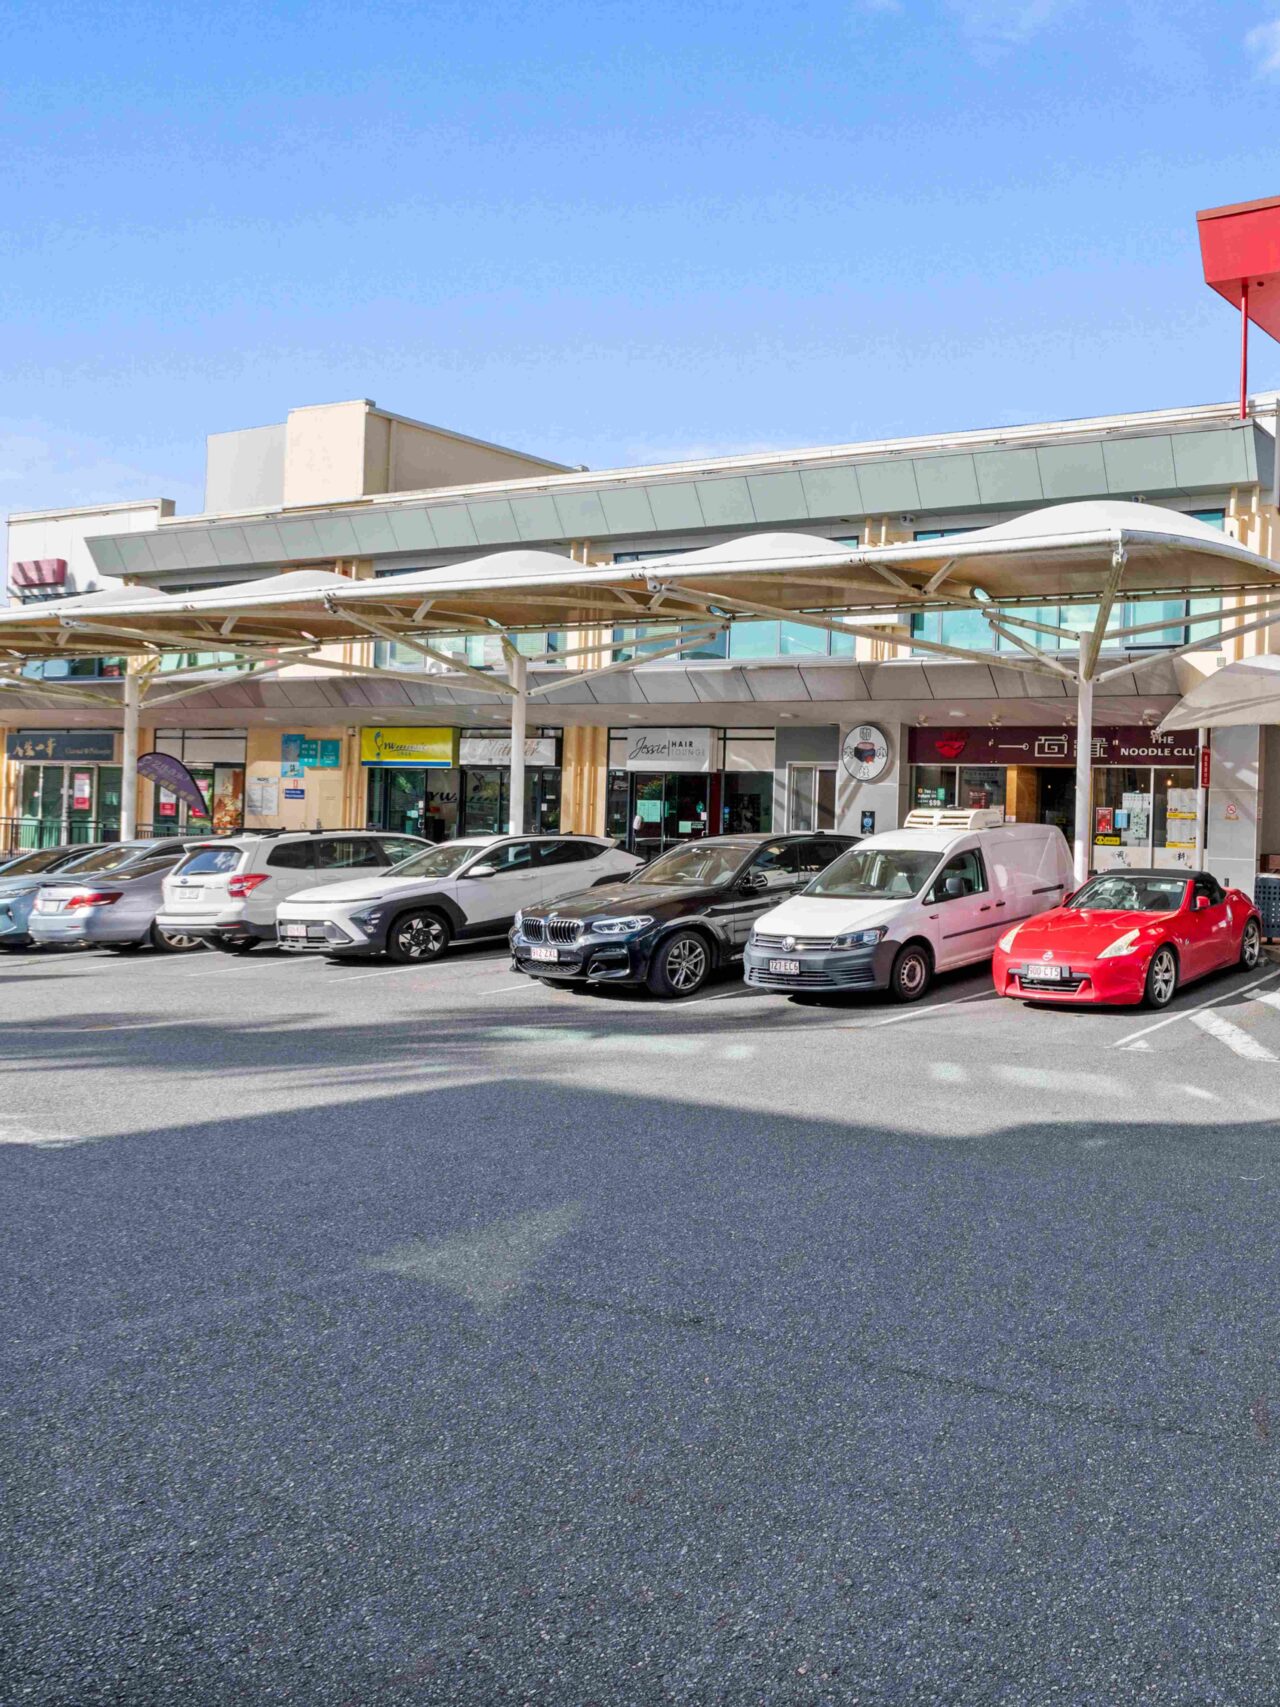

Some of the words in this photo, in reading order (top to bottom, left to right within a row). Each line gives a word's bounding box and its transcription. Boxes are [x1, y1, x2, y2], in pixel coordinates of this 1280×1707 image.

[671, 740, 694, 748] HAIR
[1151, 736, 1175, 744] THE
[629, 736, 667, 760] Jessie
[671, 748, 706, 756] LOUNGE
[1120, 748, 1172, 756] NOODLE
[1173, 748, 1196, 756] CLU
